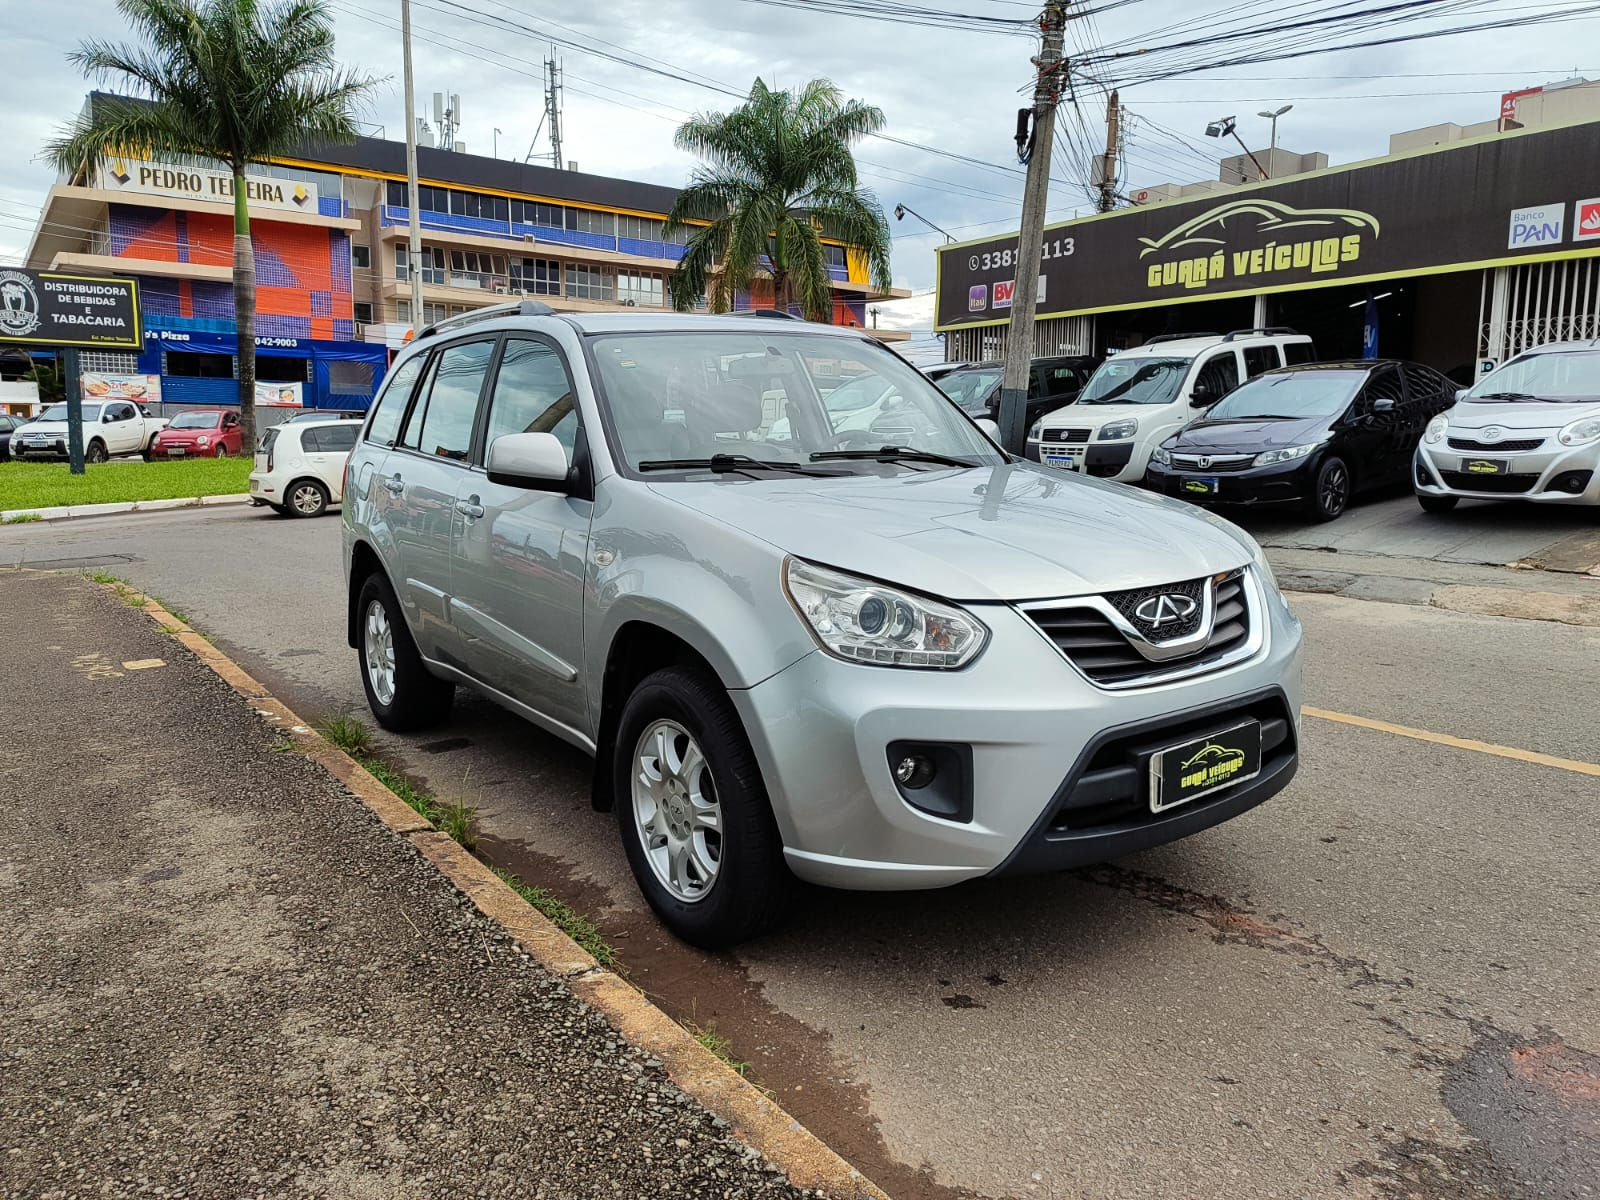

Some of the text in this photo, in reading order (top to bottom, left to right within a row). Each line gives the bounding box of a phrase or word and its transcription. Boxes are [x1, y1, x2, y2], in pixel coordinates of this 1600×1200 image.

[139, 167, 284, 203] PEDRO TEIEIRA
[1514, 211, 1545, 222] Banco
[1512, 221, 1559, 244] PAN
[1041, 237, 1076, 260] 113
[1147, 234, 1361, 289] GUARÁ VEÍCULOS
[44, 282, 128, 296] DISTRIBUIDORA
[58, 294, 116, 306] DE BEBIDAS
[970, 296, 985, 308] Itaú
[85, 306, 92, 315] E
[51, 313, 126, 327] TABACARIA
[144, 330, 190, 341] o's Pizza
[254, 337, 298, 347] 042-9003
